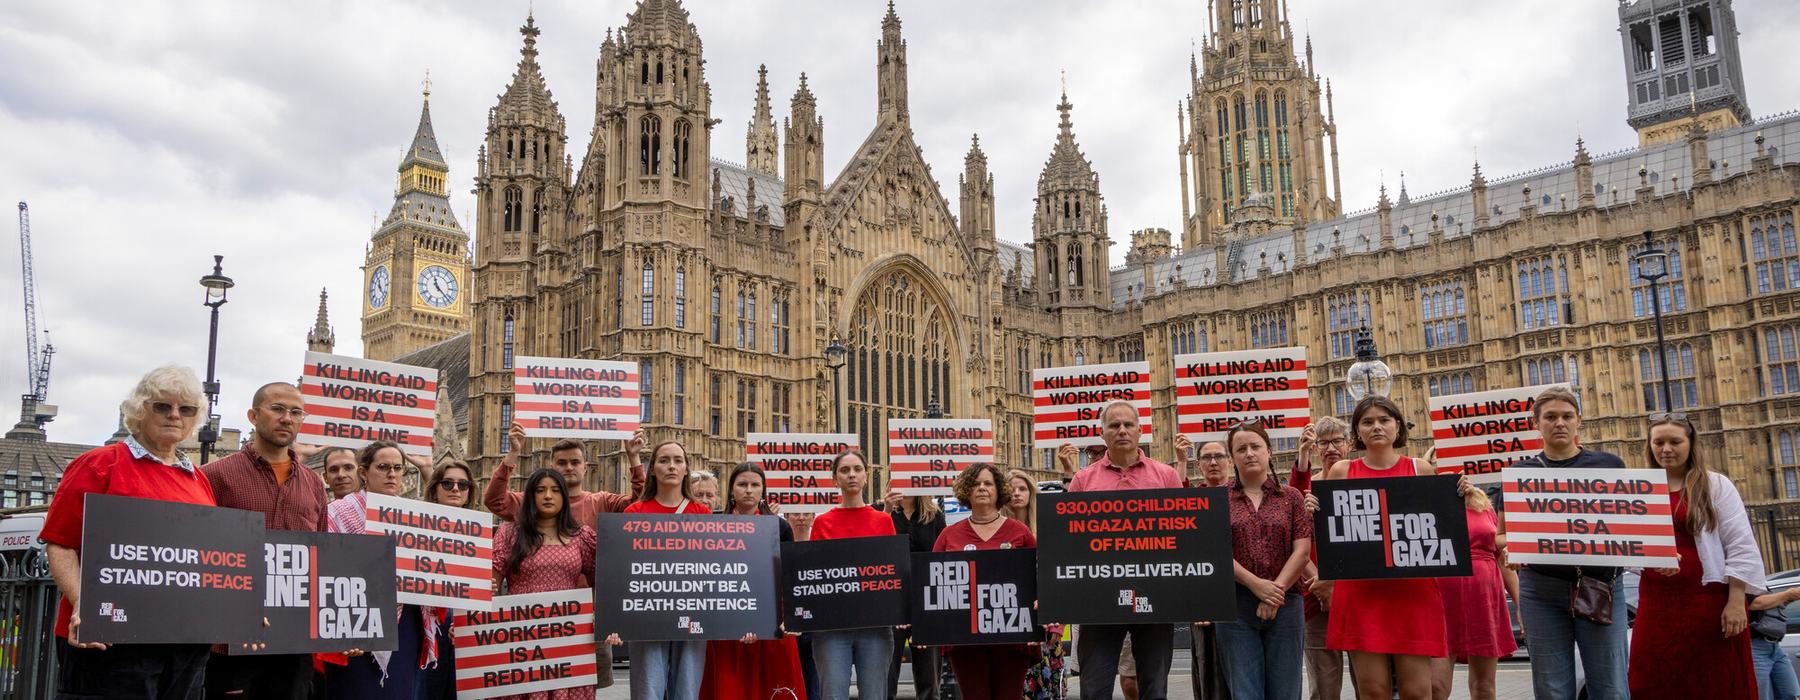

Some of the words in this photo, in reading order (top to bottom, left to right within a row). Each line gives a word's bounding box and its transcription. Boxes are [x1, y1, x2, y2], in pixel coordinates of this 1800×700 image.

[527, 366, 595, 380] KILLING
[598, 369, 627, 382] AID
[1187, 360, 1259, 377] KILLING
[1263, 358, 1294, 372] AID
[316, 363, 390, 385] KILLING
[395, 374, 426, 390] AID
[1044, 373, 1107, 389] KILLING
[1111, 371, 1139, 384] AID
[533, 382, 622, 398] WORKERS
[1194, 377, 1289, 395] WORKERS
[322, 382, 418, 408] WORKERS
[1050, 388, 1134, 405] WORKERS
[562, 400, 578, 413] IS
[582, 401, 594, 413] A
[1226, 398, 1243, 412] IS
[1246, 398, 1260, 411] A
[1443, 399, 1521, 420] KILLING
[352, 406, 369, 421] IS
[373, 409, 385, 423] A
[1077, 408, 1092, 420] IS
[539, 416, 574, 429] RED
[580, 418, 617, 431] LINE
[1056, 425, 1089, 438] RED
[1452, 416, 1534, 438] WORKE
[324, 422, 364, 439] RED
[367, 427, 409, 444] LINE
[899, 428, 956, 439] KILLING
[959, 428, 983, 439] AID
[757, 442, 818, 454] KILLING
[904, 444, 979, 455] WORKERS
[1487, 439, 1506, 453] IS
[1511, 437, 1525, 452] A
[763, 459, 833, 471] WORKER
[930, 459, 943, 471] IS
[946, 459, 956, 471] A
[1464, 459, 1504, 475] RED
[790, 475, 804, 488] IS
[807, 475, 818, 488] A
[911, 476, 941, 487] RED
[1517, 478, 1608, 494] KILLING
[1613, 480, 1653, 494] AID
[768, 492, 800, 504] RED
[804, 492, 839, 504] LINE
[1056, 500, 1124, 516] 930,000
[1126, 497, 1209, 512] CHILDREN
[1332, 489, 1380, 516] RED
[1526, 498, 1648, 515] WORKERS
[379, 506, 449, 531] KILLING
[453, 519, 482, 537] AID
[623, 521, 651, 533] 479
[653, 521, 680, 533] AID
[681, 521, 756, 534] WORKERS
[1069, 520, 1085, 533] IN
[1087, 518, 1133, 532] GAZA
[1136, 518, 1156, 530] AT
[1158, 516, 1198, 530] RISK
[1328, 515, 1382, 542] LINE
[1389, 513, 1438, 540] FOR
[1566, 519, 1589, 534] IS
[1594, 519, 1610, 535] A
[2, 536, 31, 545] POLICE
[633, 539, 686, 550] KILLED
[688, 539, 702, 550] IN
[704, 539, 746, 550] GAZA
[1090, 538, 1113, 551] OF
[1115, 537, 1177, 551] FAMINE
[1538, 538, 1586, 554] RED
[1590, 540, 1645, 556] LINE
[110, 544, 148, 561] USE
[151, 546, 198, 564] YOUR
[200, 550, 246, 568] VOICE
[264, 543, 310, 575] RED
[1392, 539, 1457, 567] GAZA
[415, 555, 432, 573] IS
[435, 559, 447, 575] A
[632, 563, 721, 575] DELIVERING
[723, 563, 748, 574] AID
[798, 569, 823, 581] USE
[824, 567, 857, 579] YOUR
[858, 565, 895, 577] VOICE
[930, 561, 969, 586] RED
[1056, 566, 1086, 579] LET
[1088, 565, 1111, 578] US
[1113, 563, 1183, 578] DELIVER
[1185, 562, 1214, 576] AID
[100, 568, 163, 585] STAND
[166, 571, 200, 587] FOR
[202, 573, 252, 590] PEACE
[719, 581, 738, 592] BE
[740, 581, 750, 592] A
[793, 584, 834, 596] STAND
[835, 582, 860, 593] FOR
[861, 579, 902, 592] PEACE
[264, 575, 309, 607] INE
[319, 577, 367, 607] FOR
[429, 579, 470, 599] LINE
[977, 583, 1018, 609] FOR
[623, 599, 674, 611] DEATH
[676, 599, 757, 611] SENTENCE
[924, 585, 970, 611] LINE
[467, 604, 544, 625] KILLING
[548, 600, 580, 617] AID
[978, 608, 1033, 634] GAZA
[319, 608, 384, 639] GAZA
[474, 621, 576, 646] WORKERS
[509, 647, 528, 663] IS
[531, 645, 545, 661] A
[484, 668, 525, 688] RED
[529, 662, 571, 682] LINE
